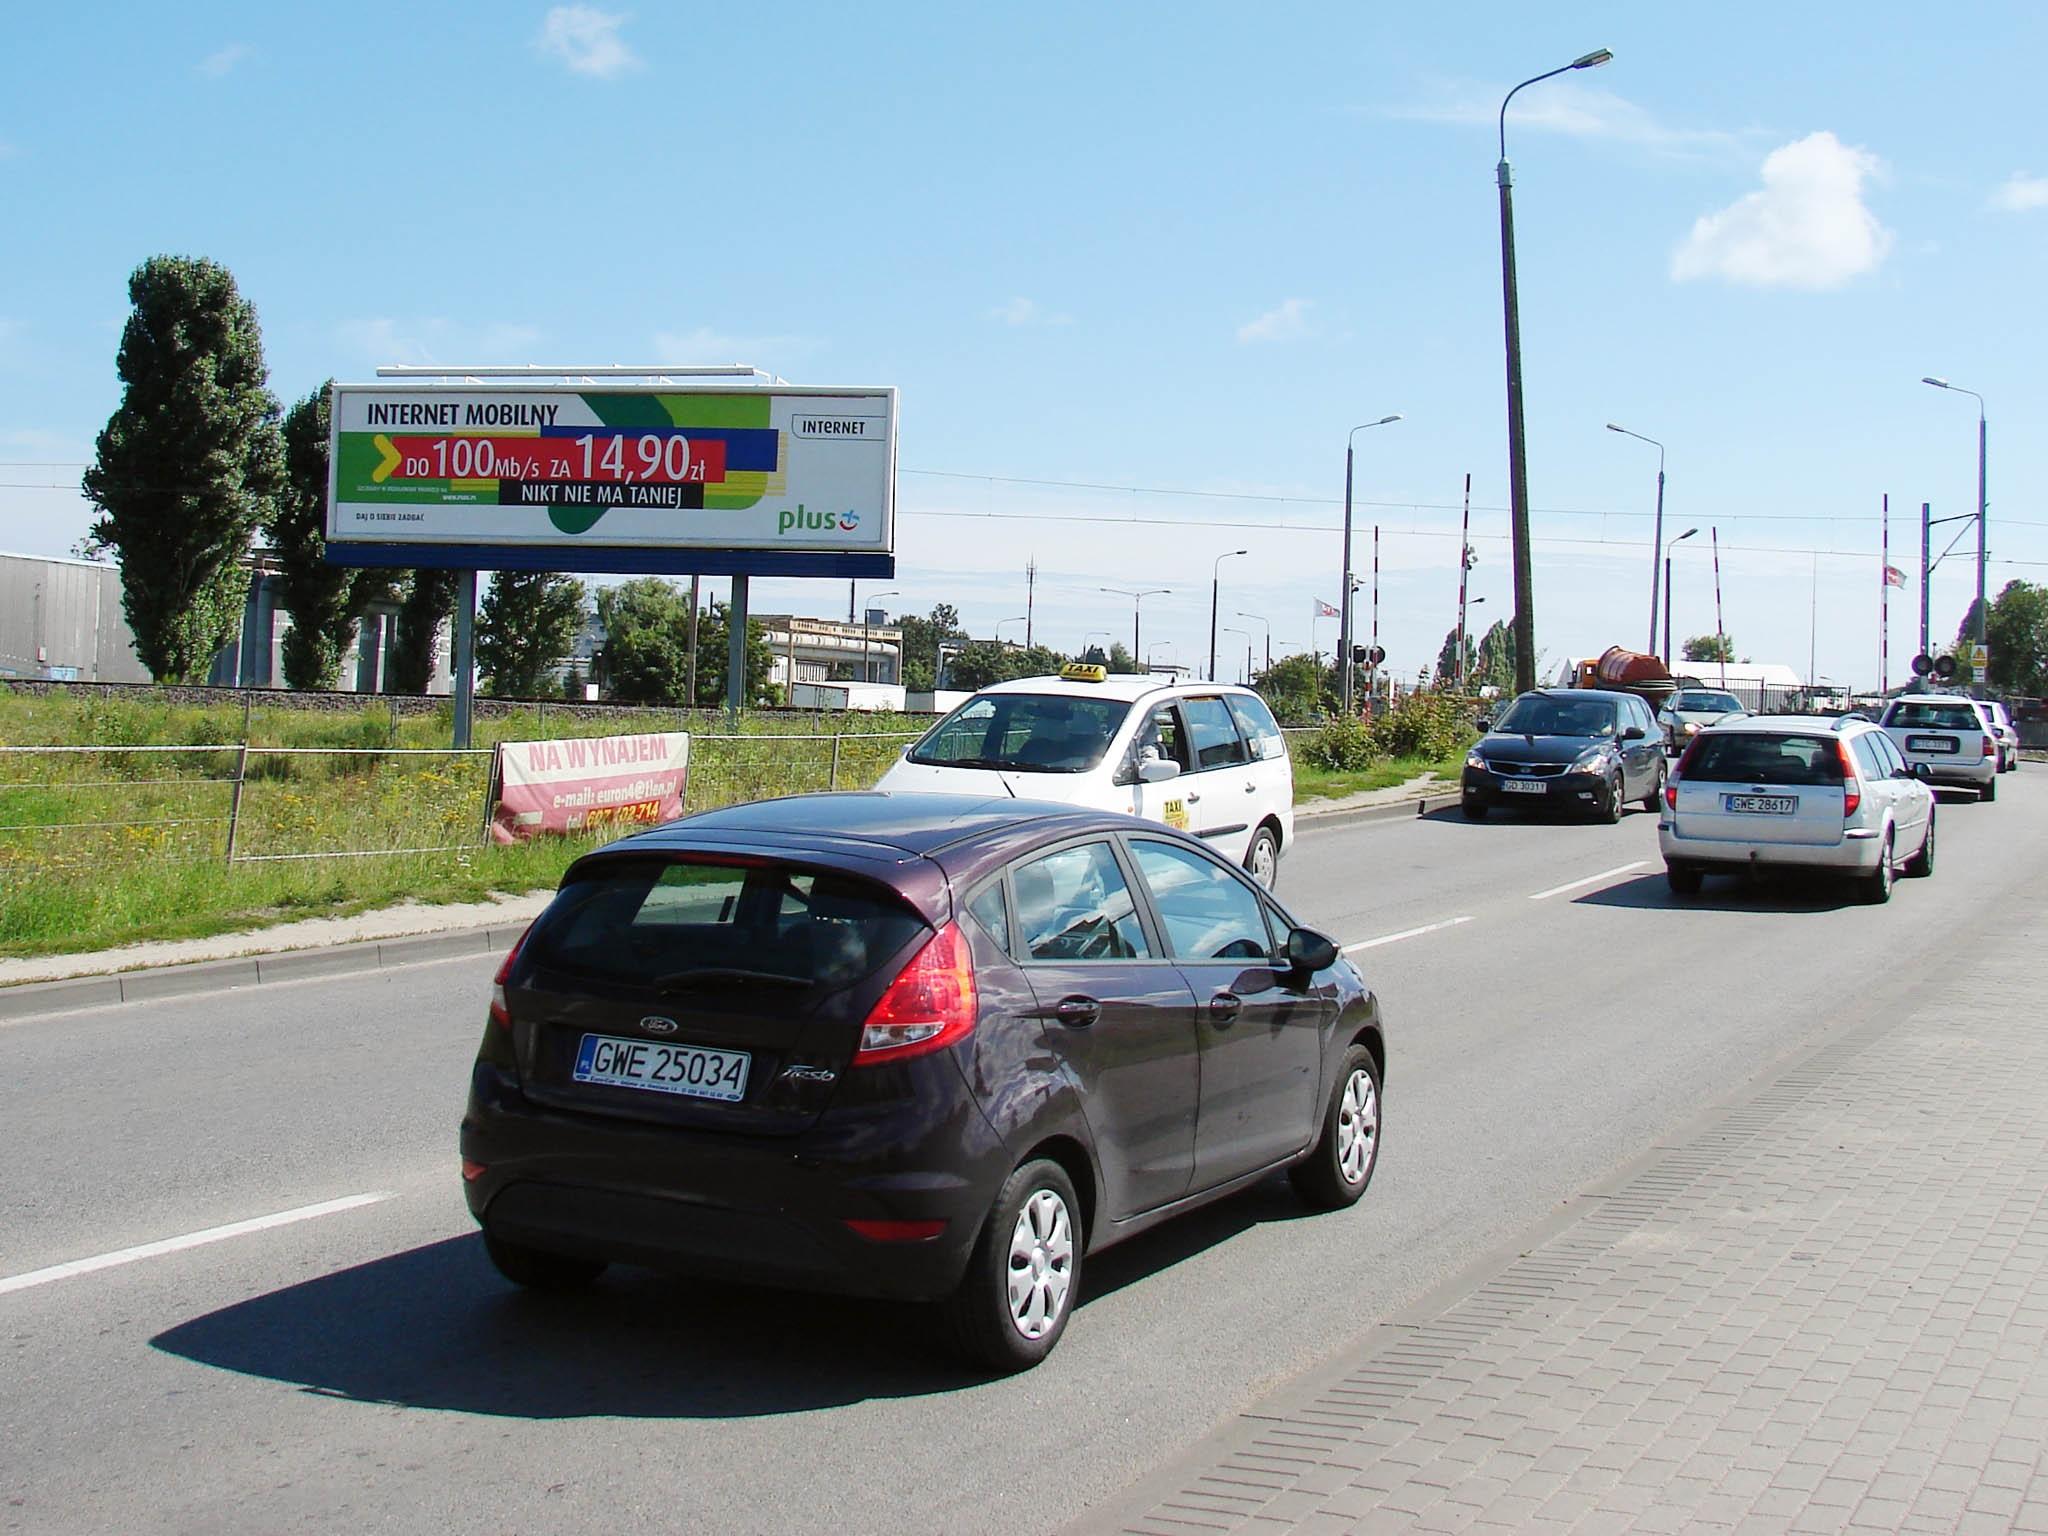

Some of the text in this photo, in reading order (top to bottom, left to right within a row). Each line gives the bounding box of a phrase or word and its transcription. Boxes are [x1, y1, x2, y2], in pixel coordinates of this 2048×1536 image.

[367, 403, 559, 426] INTERNET MOBILNY
[405, 457, 430, 477] DO
[432, 439, 540, 481] 100Mb/s
[550, 460, 571, 478] ZA
[521, 485, 682, 509] NIKT NIE MA TANIEJ
[778, 504, 837, 535] plus
[1067, 664, 1099, 673] TAXI
[529, 734, 668, 772] NA WYNAJEM
[553, 788, 594, 808] e-mail:
[1165, 800, 1181, 813] TAXI
[1733, 798, 1791, 811] GWE 28617
[594, 1042, 743, 1090] GWE 25034
